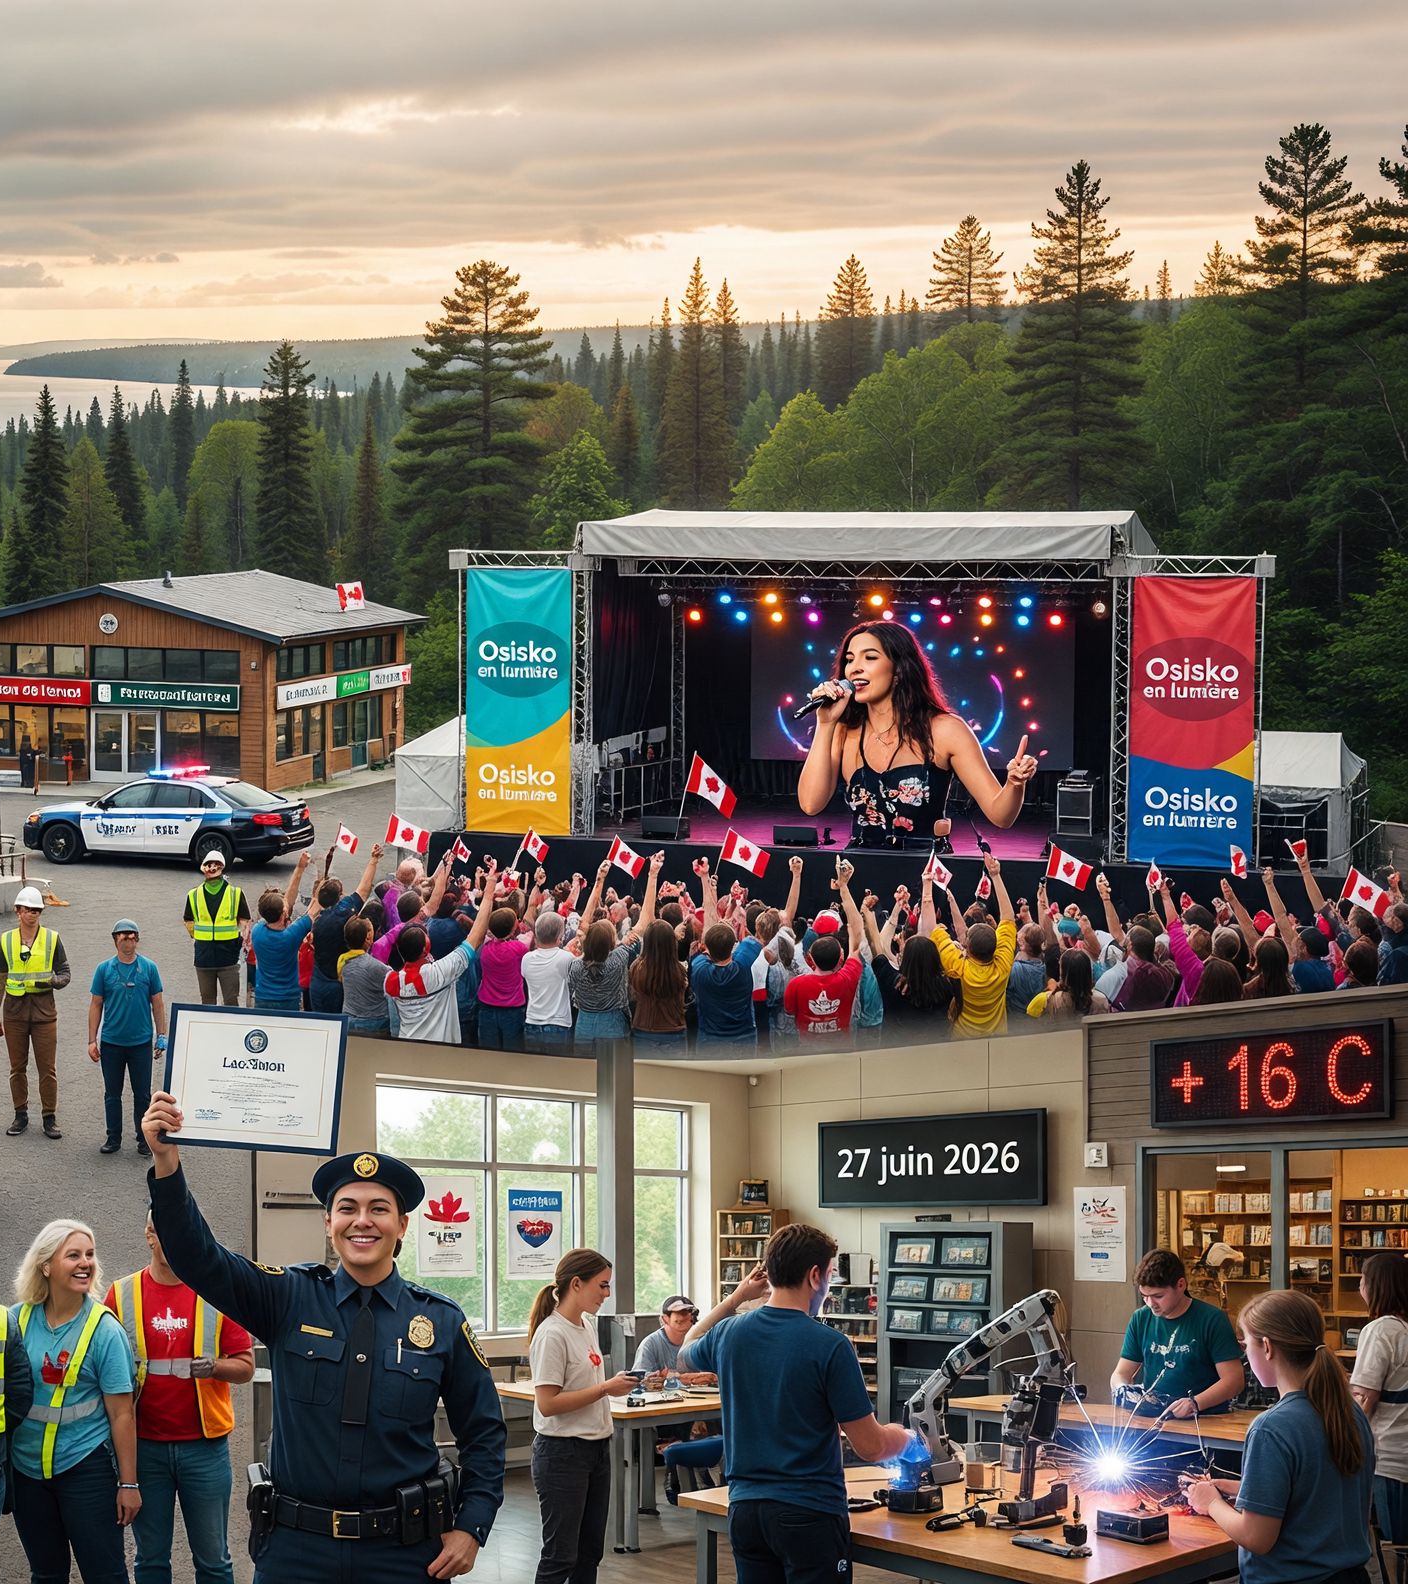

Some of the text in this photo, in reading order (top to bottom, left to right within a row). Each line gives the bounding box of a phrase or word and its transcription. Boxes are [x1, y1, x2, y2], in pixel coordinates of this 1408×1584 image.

[478, 640, 557, 663] Osisko
[478, 666, 497, 678] en
[1145, 657, 1240, 683] Osisko
[1143, 686, 1165, 698] en
[478, 763, 556, 786] Osisko
[1145, 786, 1238, 813] Osisko
[1142, 814, 1165, 827] en
[1227, 1042, 1297, 1110] 16
[1327, 1035, 1372, 1105] C
[837, 1141, 1020, 1186] 27 juin 2026
